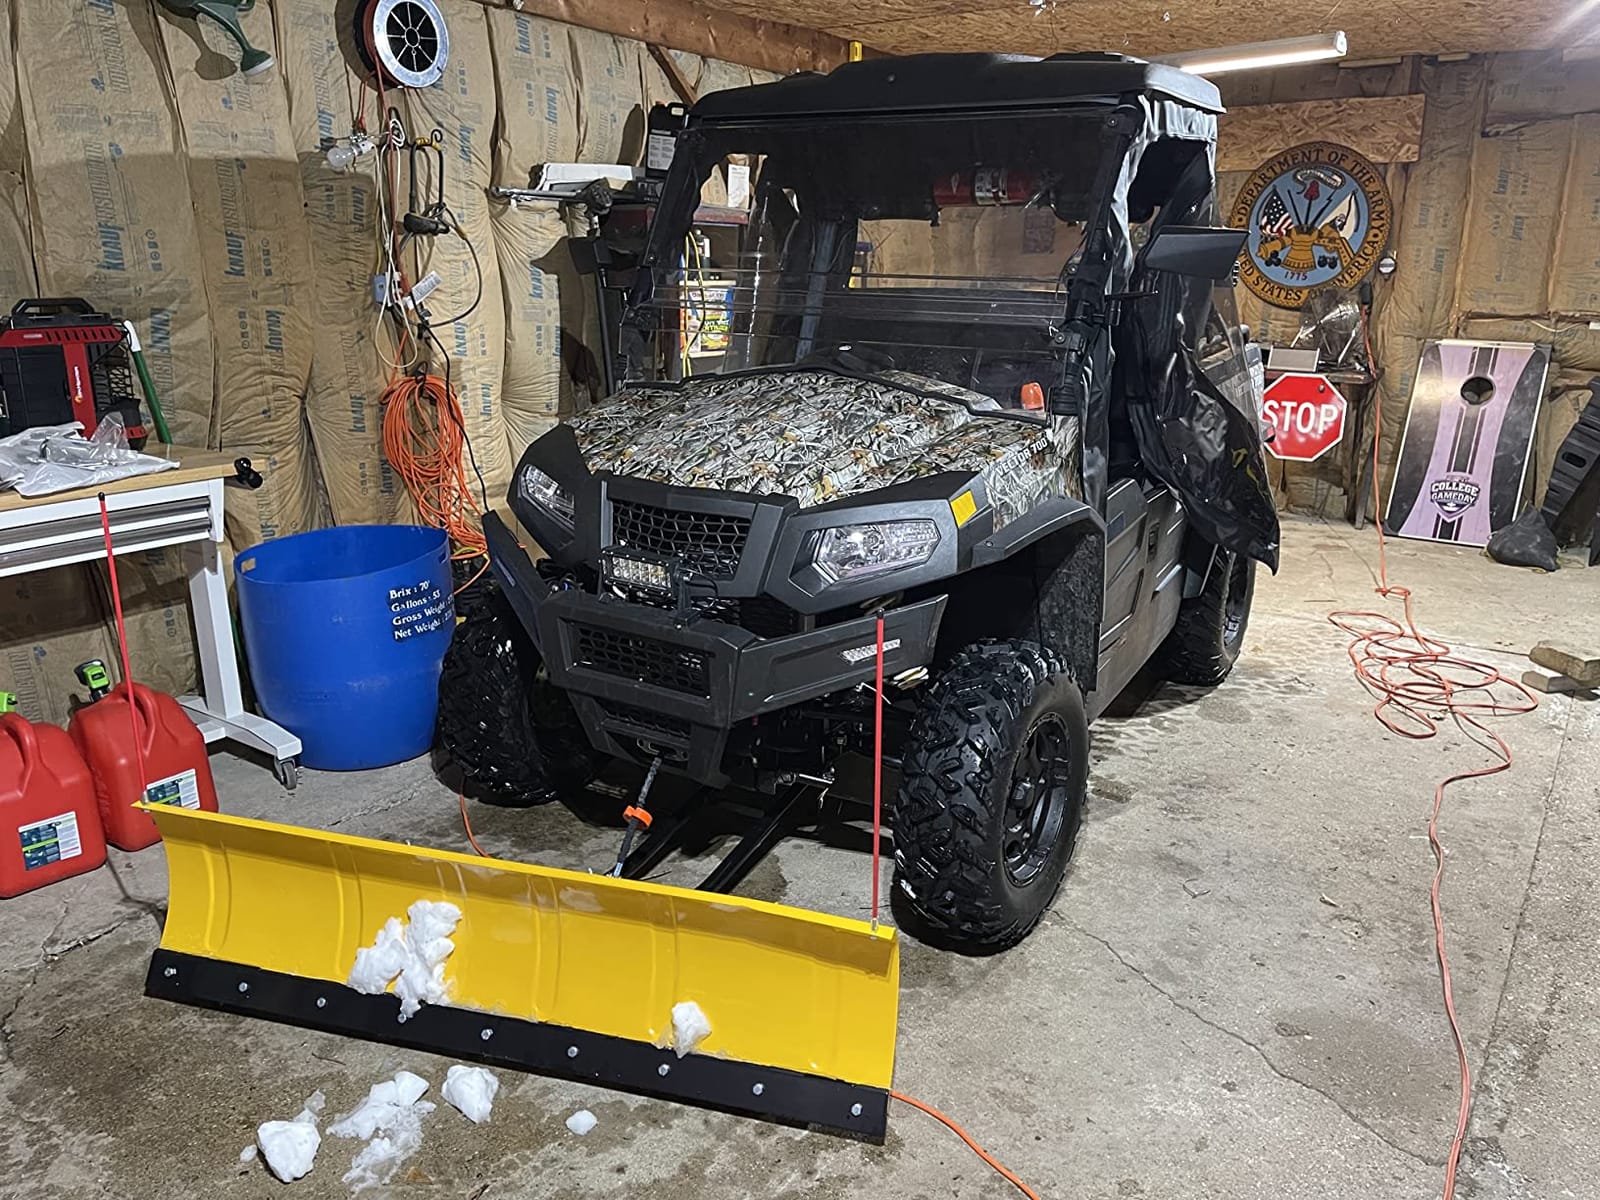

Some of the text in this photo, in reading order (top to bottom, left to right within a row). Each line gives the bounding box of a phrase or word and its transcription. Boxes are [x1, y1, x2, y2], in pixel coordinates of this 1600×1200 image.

[515, 14, 531, 55] KNAUF
[545, 87, 560, 126] KNAUF
[84, 141, 126, 271] KNAUF INSULATION
[1237, 149, 1323, 216] DEPARTMENT
[1328, 151, 1349, 165] OF
[1350, 160, 1375, 188] THE
[1368, 190, 1387, 234] ARMY
[224, 231, 246, 277] KNAUF
[1253, 275, 1303, 301] STATES
[1332, 240, 1379, 285] MERICA
[528, 262, 544, 299] KNAU
[1285, 271, 1308, 281] 1775
[265, 309, 286, 350] KNAUF
[452, 321, 469, 357] KNAUF
[348, 393, 366, 433] KNAUF
[480, 383, 493, 417] KNAUF
[1264, 399, 1339, 435] STOP
[995, 438, 1048, 477] VECTOR 700
[1431, 481, 1479, 497] COLLEGE
[1431, 491, 1476, 503] GAMEDAY
[389, 588, 411, 600] Brix
[391, 596, 427, 612] Gallons
[392, 612, 422, 626] Gross
[394, 617, 441, 640] Net Weight
[7, 650, 42, 722] NSULATION
